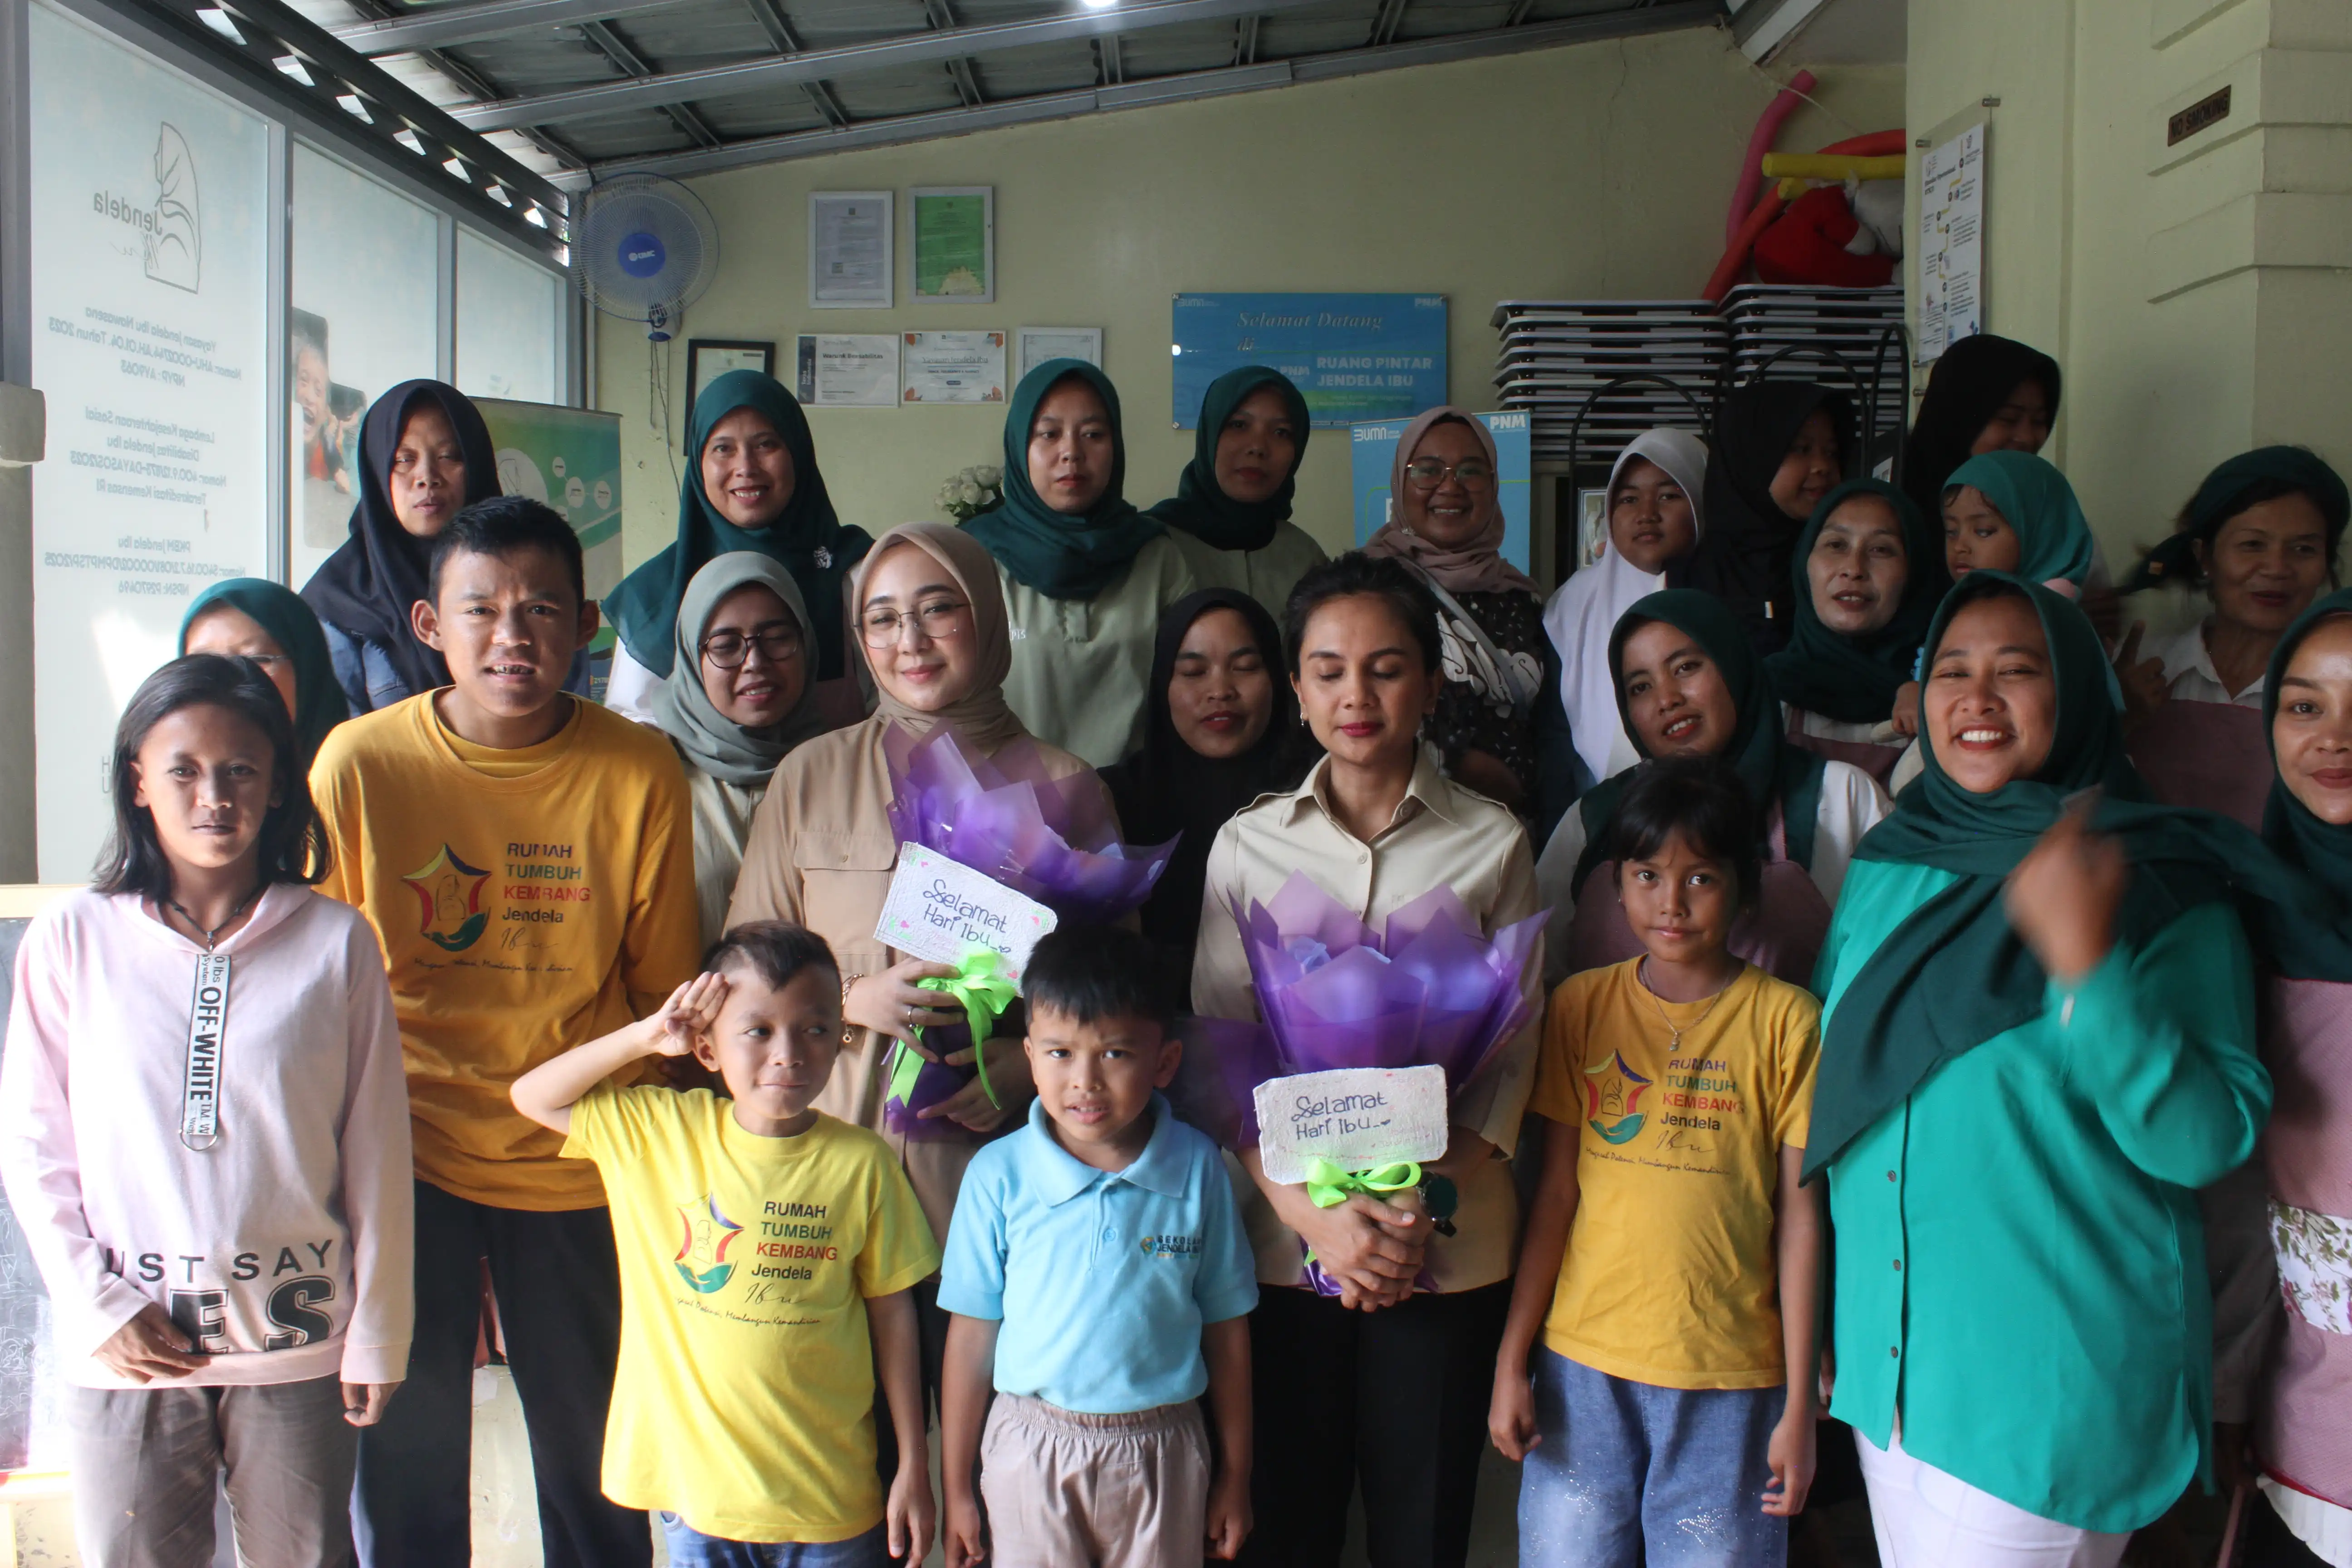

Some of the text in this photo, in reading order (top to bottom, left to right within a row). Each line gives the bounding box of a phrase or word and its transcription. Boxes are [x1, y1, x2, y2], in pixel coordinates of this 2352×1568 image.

[1237, 312, 1382, 331] Selamat Datang
[1237, 337, 1254, 352] di
[1317, 358, 1432, 369] RUANG PINTAR
[1317, 375, 1413, 387] JENDELA IBU
[1490, 414, 1526, 429] PNM
[507, 843, 572, 858] RUMAH
[505, 864, 581, 879] TUMBUH
[504, 885, 591, 901] KEMBANG
[923, 879, 1007, 933] Selamat
[502, 907, 564, 923] Jendela
[924, 904, 961, 931] Hari
[190, 987, 221, 1100] OFF-WHITE
[1668, 1058, 1725, 1072] RUMAH
[1666, 1075, 1737, 1092] TUMBUH
[1291, 1091, 1388, 1122] Selamat
[1662, 1093, 1745, 1114] KEMBANG
[1297, 1118, 1331, 1140] Hari
[1661, 1112, 1720, 1131] Jendela
[764, 1201, 826, 1218] RUMAH
[761, 1222, 833, 1240] TUMBUH
[232, 1240, 333, 1280] SAY
[756, 1243, 838, 1260] KEMBANG
[752, 1264, 812, 1280] Jendela
[745, 1283, 807, 1304] Ibu
